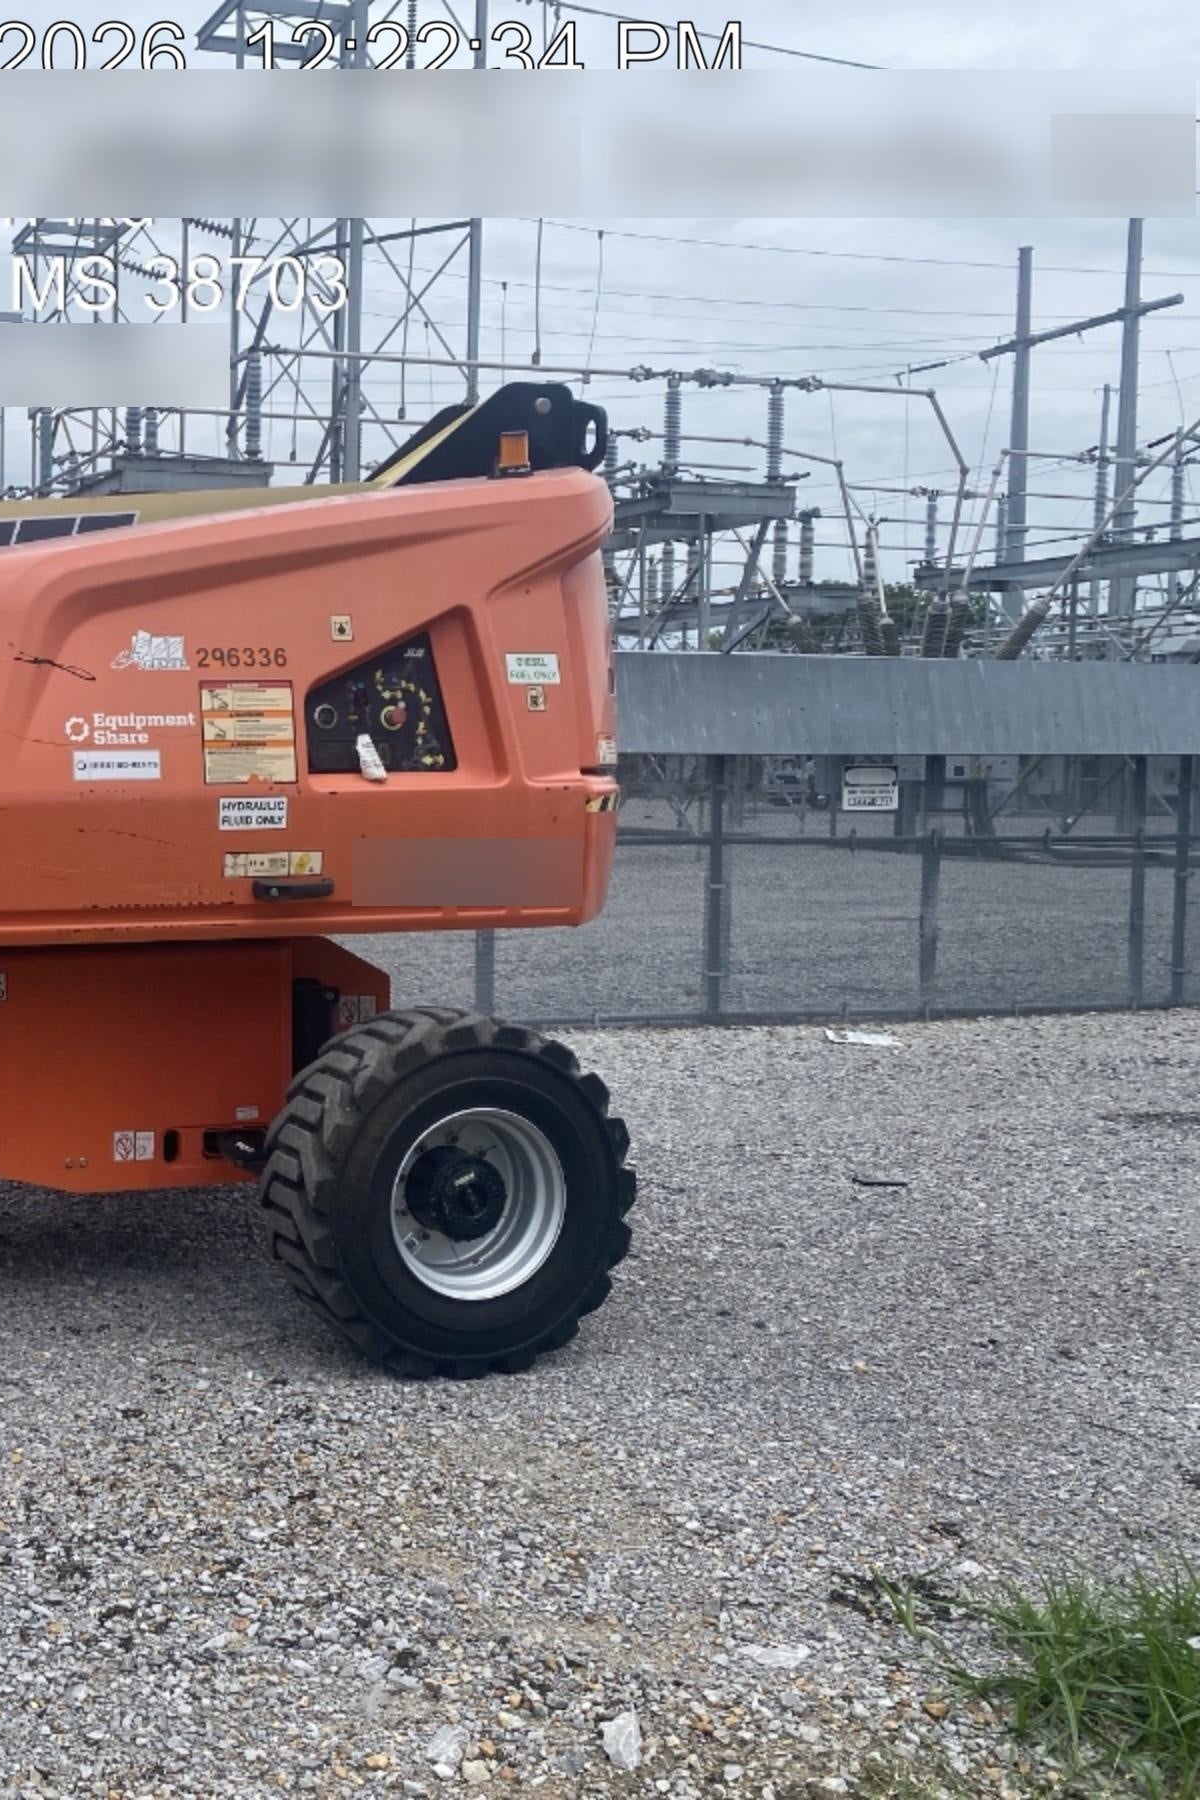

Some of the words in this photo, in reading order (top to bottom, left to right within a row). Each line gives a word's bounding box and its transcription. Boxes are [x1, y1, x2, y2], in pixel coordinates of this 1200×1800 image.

[196, 647, 287, 668] 296336
[93, 713, 196, 729] Equipment
[93, 730, 149, 745] Share
[222, 801, 285, 811] HYDRAULIC
[222, 815, 253, 826] FLUID
[255, 815, 284, 825] ONLY
